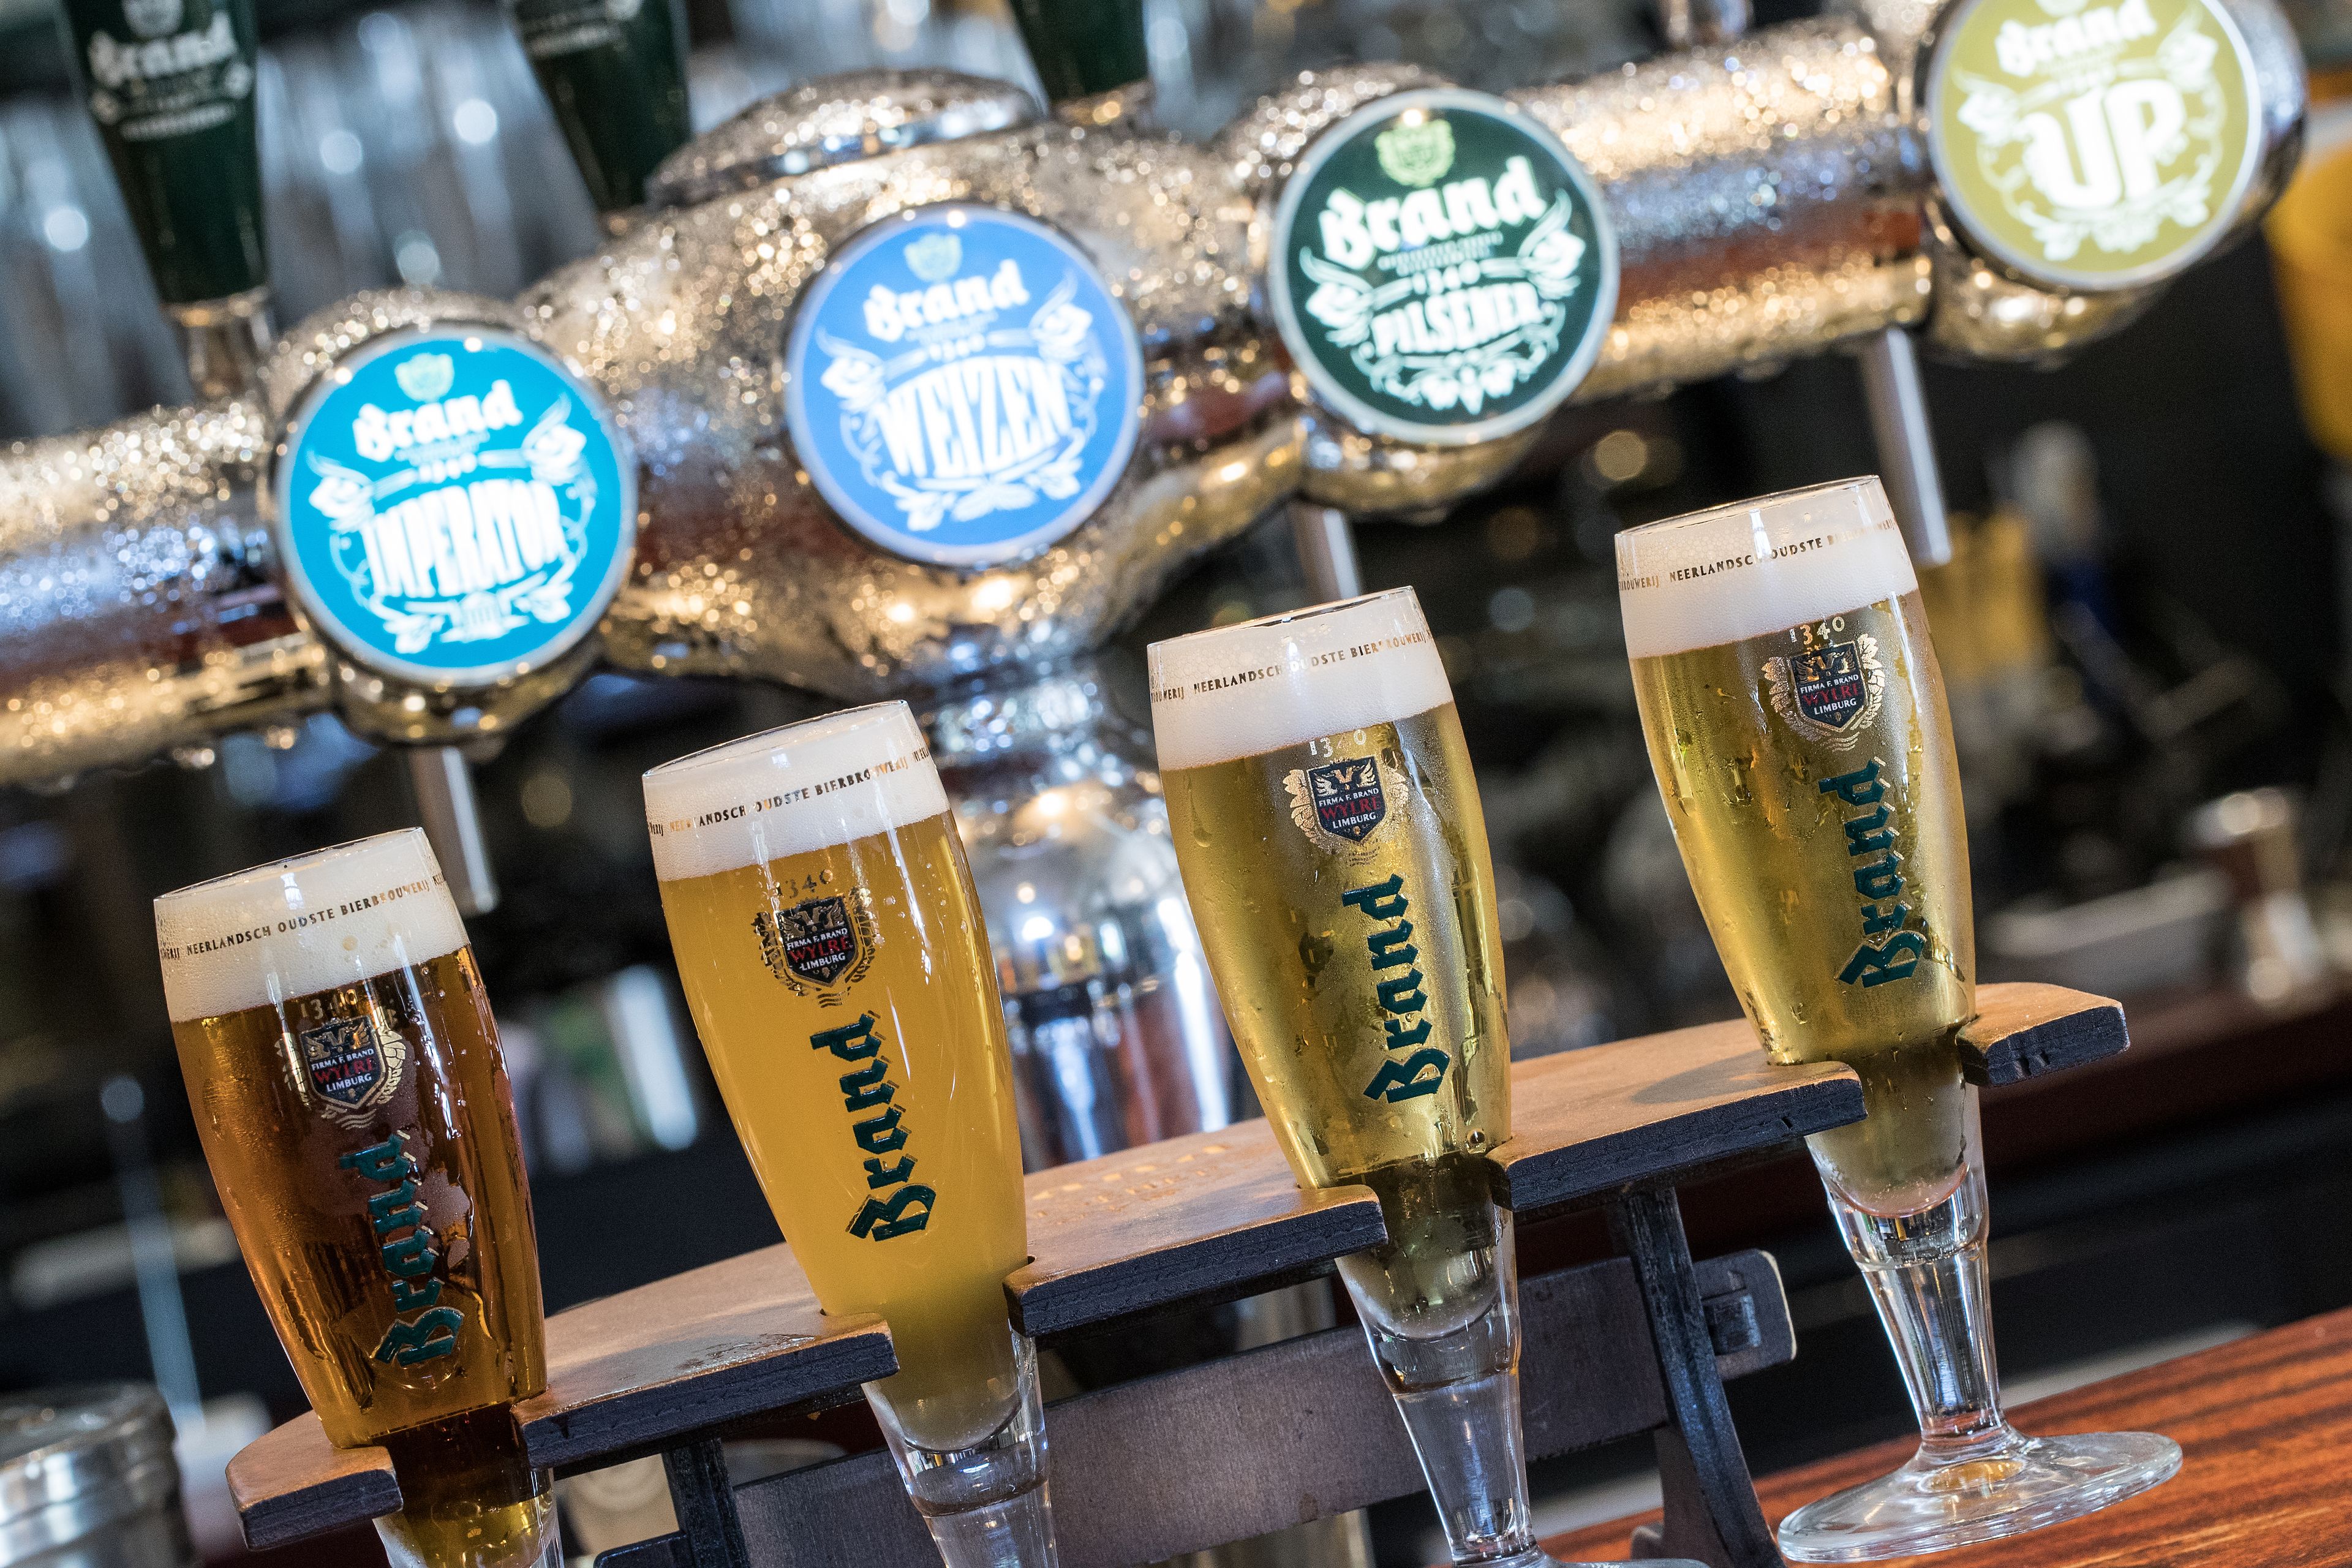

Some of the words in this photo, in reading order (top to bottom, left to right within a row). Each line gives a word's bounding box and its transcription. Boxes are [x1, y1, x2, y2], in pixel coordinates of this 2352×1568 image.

[1995, 0, 2157, 77] Brand
[2022, 78, 2187, 209] UP
[1319, 156, 1547, 270] Brand
[864, 258, 1029, 342] Brand
[1371, 282, 1545, 357] PILSENER
[353, 379, 523, 462] Brand
[877, 355, 1073, 478] WEIZEN
[1670, 555, 1762, 582] NEERLANDSC
[1770, 538, 1823, 560] OUDSTE
[1351, 632, 1426, 657] BIERROUWERIJ
[1789, 616, 1845, 645] 1340
[1800, 684, 1824, 695] FIRMA
[1835, 674, 1859, 685] BRAND
[1814, 698, 1856, 715] LIMBURG
[670, 805, 746, 832] NEEANDSCH
[755, 788, 809, 812] OUDSTE
[1319, 797, 1343, 807] FIRMA
[1353, 788, 1379, 799] BRAND
[1333, 812, 1376, 829] LIMBURG
[1818, 756, 1927, 988] Brand
[187, 925, 271, 956] NEERLANDSCH
[278, 909, 334, 932] OUDSTE
[340, 879, 429, 916] BIERBROUWERIJ
[786, 938, 812, 950] FIRMA
[821, 928, 848, 940] BRAND
[801, 952, 845, 971] LIMBURG
[1342, 873, 1450, 1103] Brand
[311, 1060, 337, 1071] FIRMA
[346, 1048, 374, 1061] BRAND
[326, 1073, 372, 1092] LIMBURG
[810, 1011, 937, 1242] Brand
[340, 1132, 464, 1366] Brand
